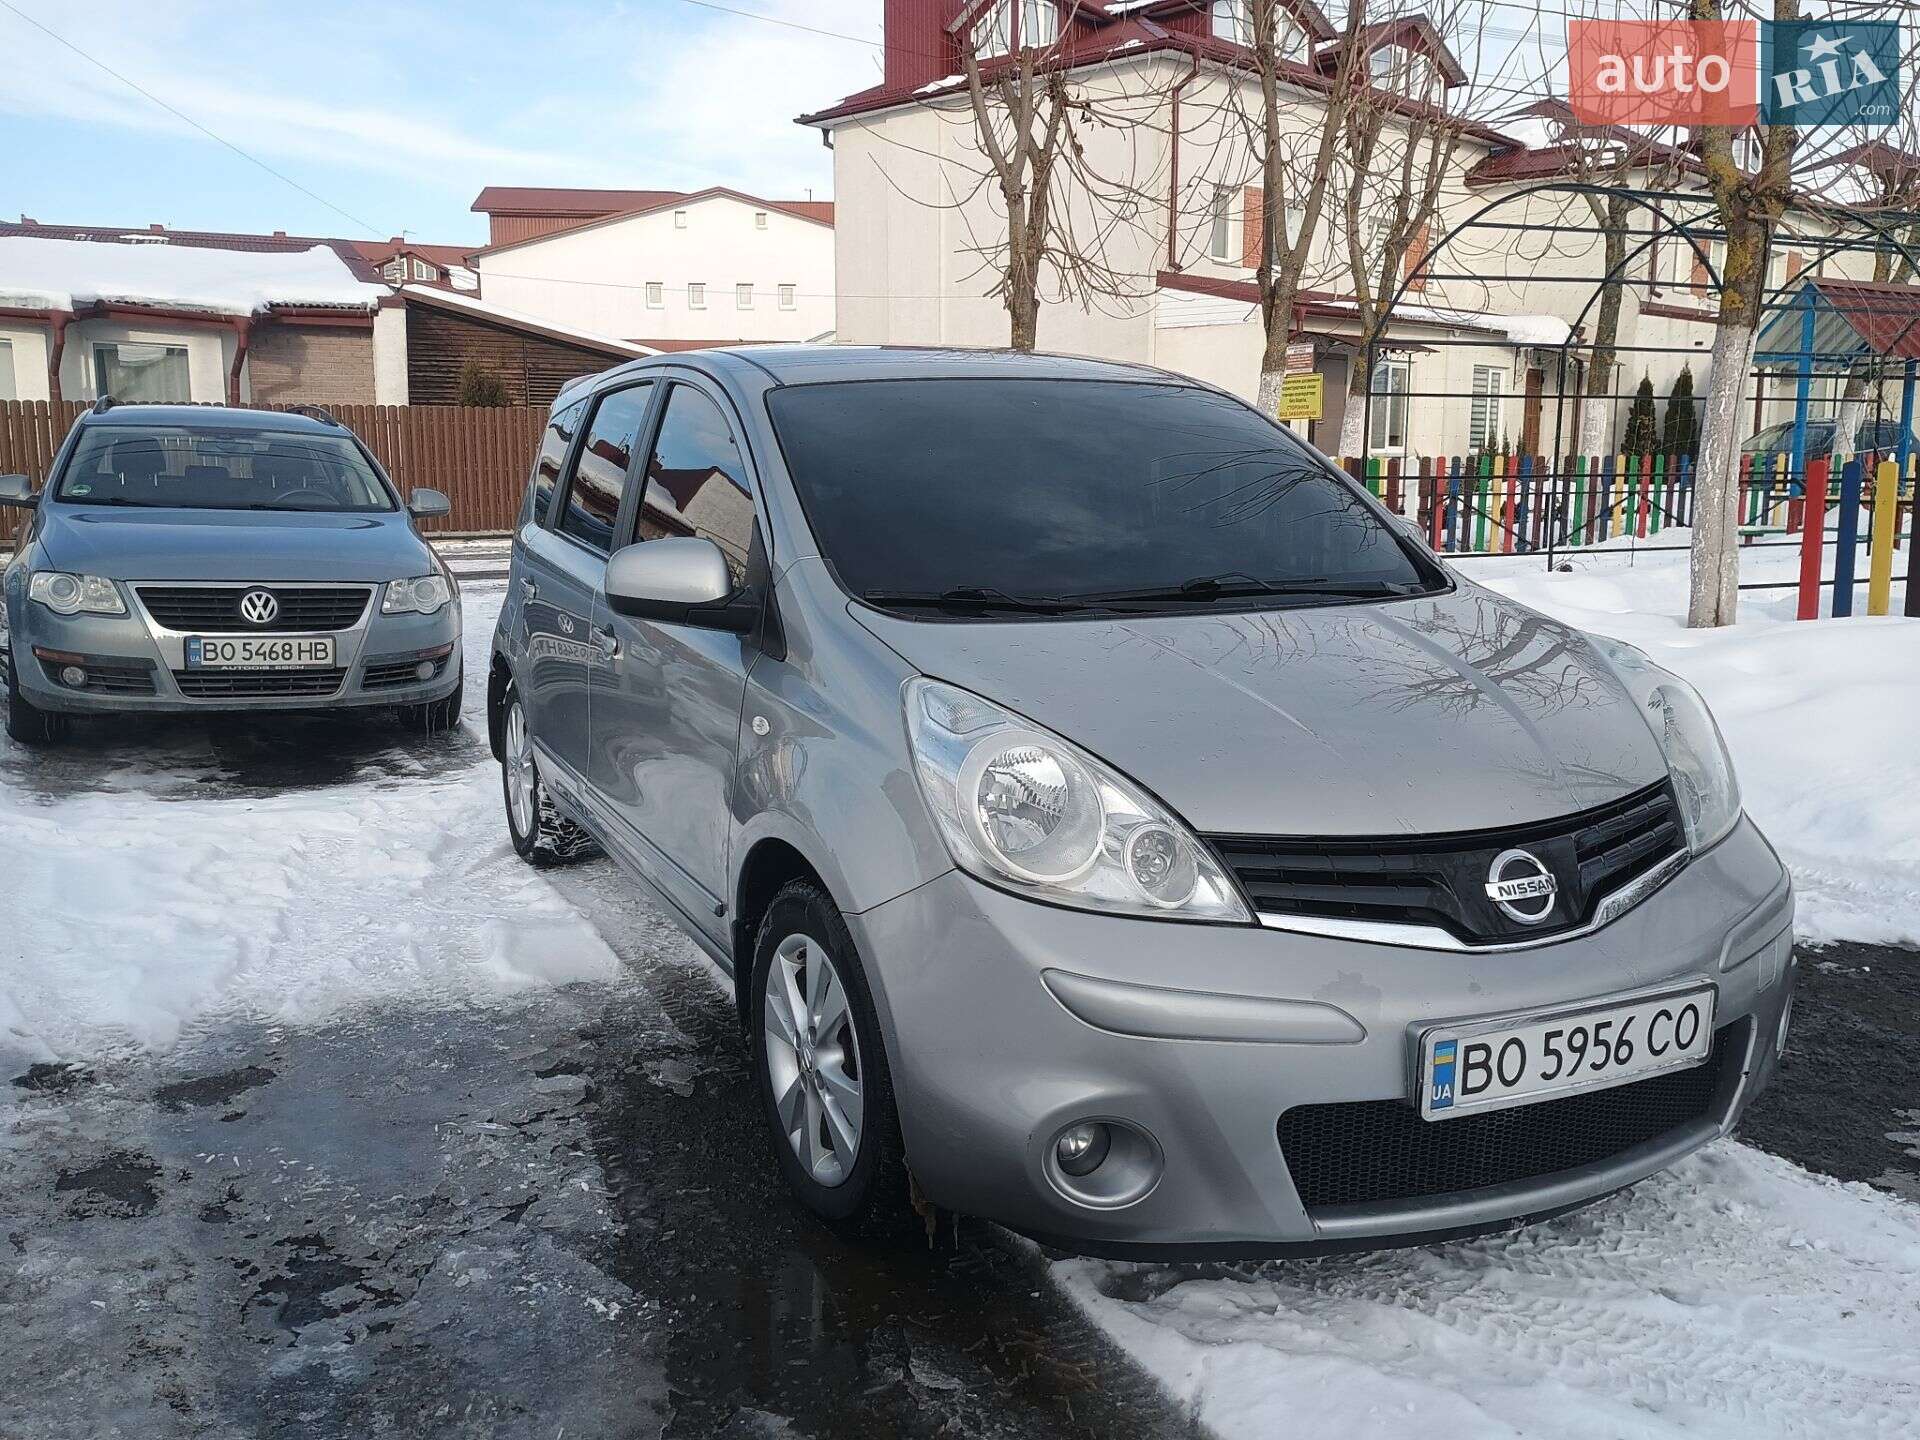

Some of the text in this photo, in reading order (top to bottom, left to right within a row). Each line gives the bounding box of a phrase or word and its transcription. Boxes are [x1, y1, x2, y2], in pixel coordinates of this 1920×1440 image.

[203, 641, 329, 661] BO 5468 HB
[1498, 878, 1555, 897] NISSAN
[1461, 1003, 1700, 1096] BO 5956 CO
[1432, 1083, 1452, 1101] UA
